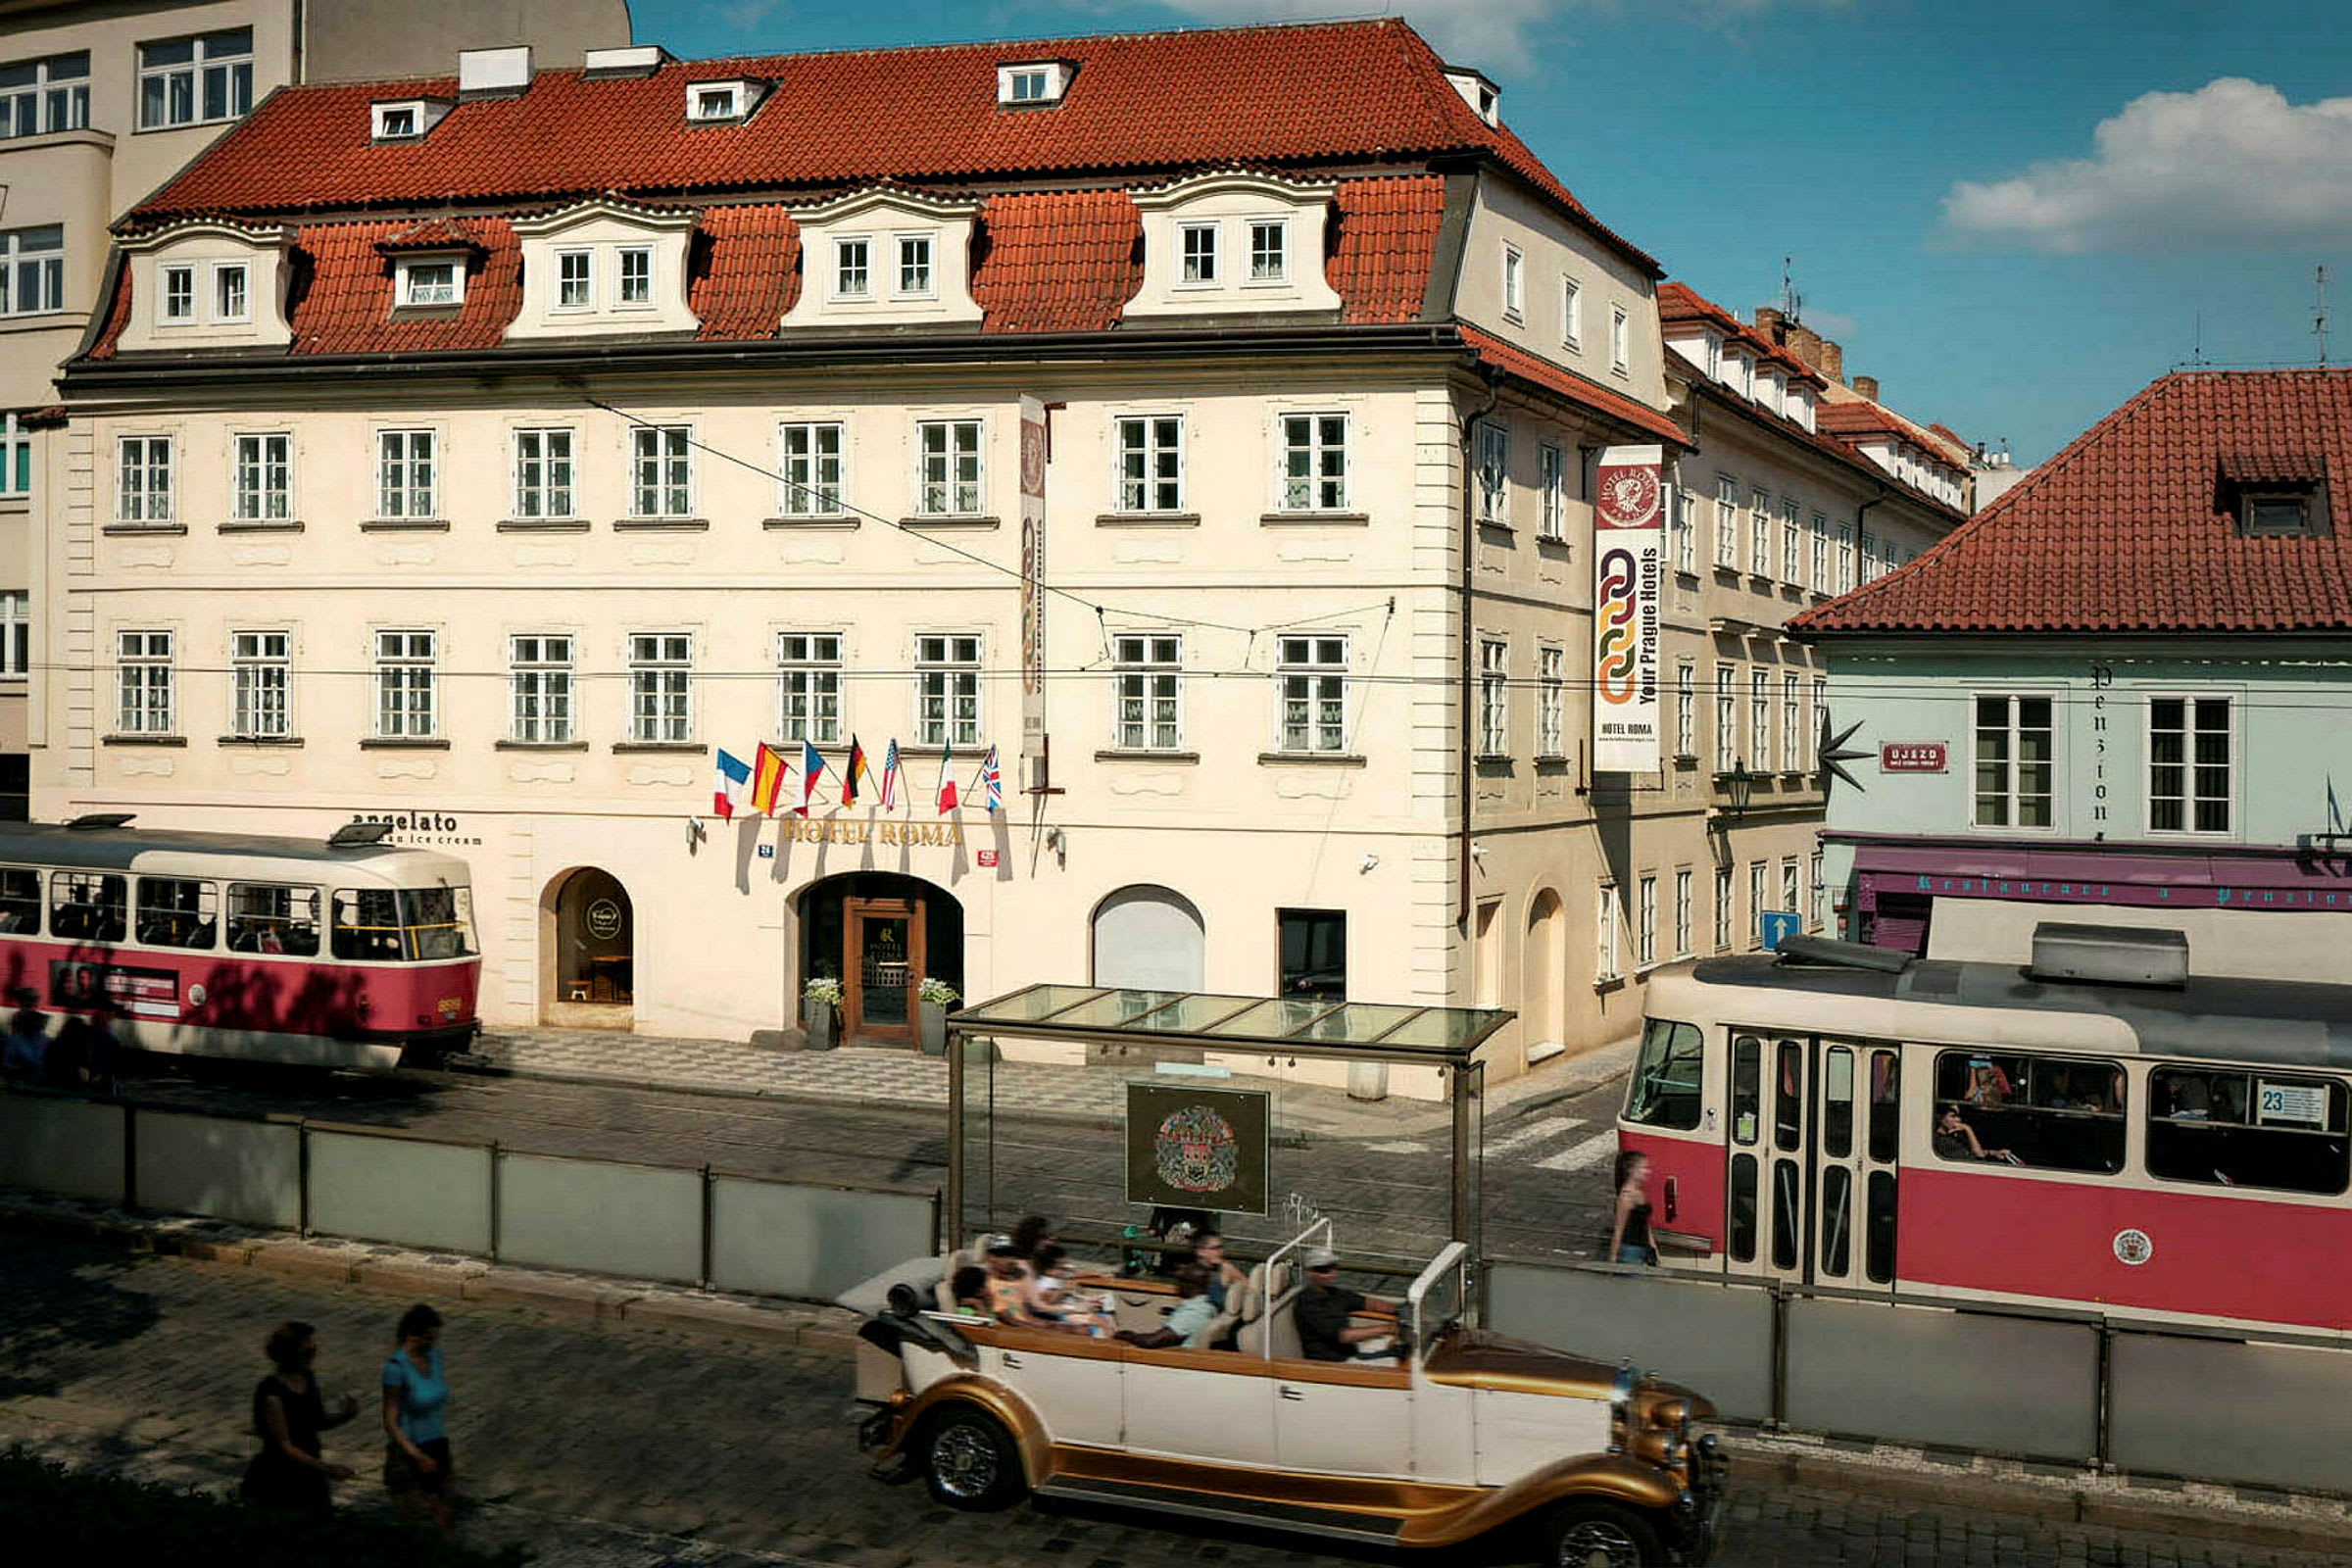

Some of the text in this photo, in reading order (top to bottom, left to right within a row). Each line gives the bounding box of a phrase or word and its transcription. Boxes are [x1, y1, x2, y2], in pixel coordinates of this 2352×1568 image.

[1640, 547, 1658, 705] Your Prague Hotels
[1602, 722, 1652, 735] HOTEL ROMA
[783, 818, 963, 846] HOTEL ROMA
[2263, 1091, 2282, 1110] 23
